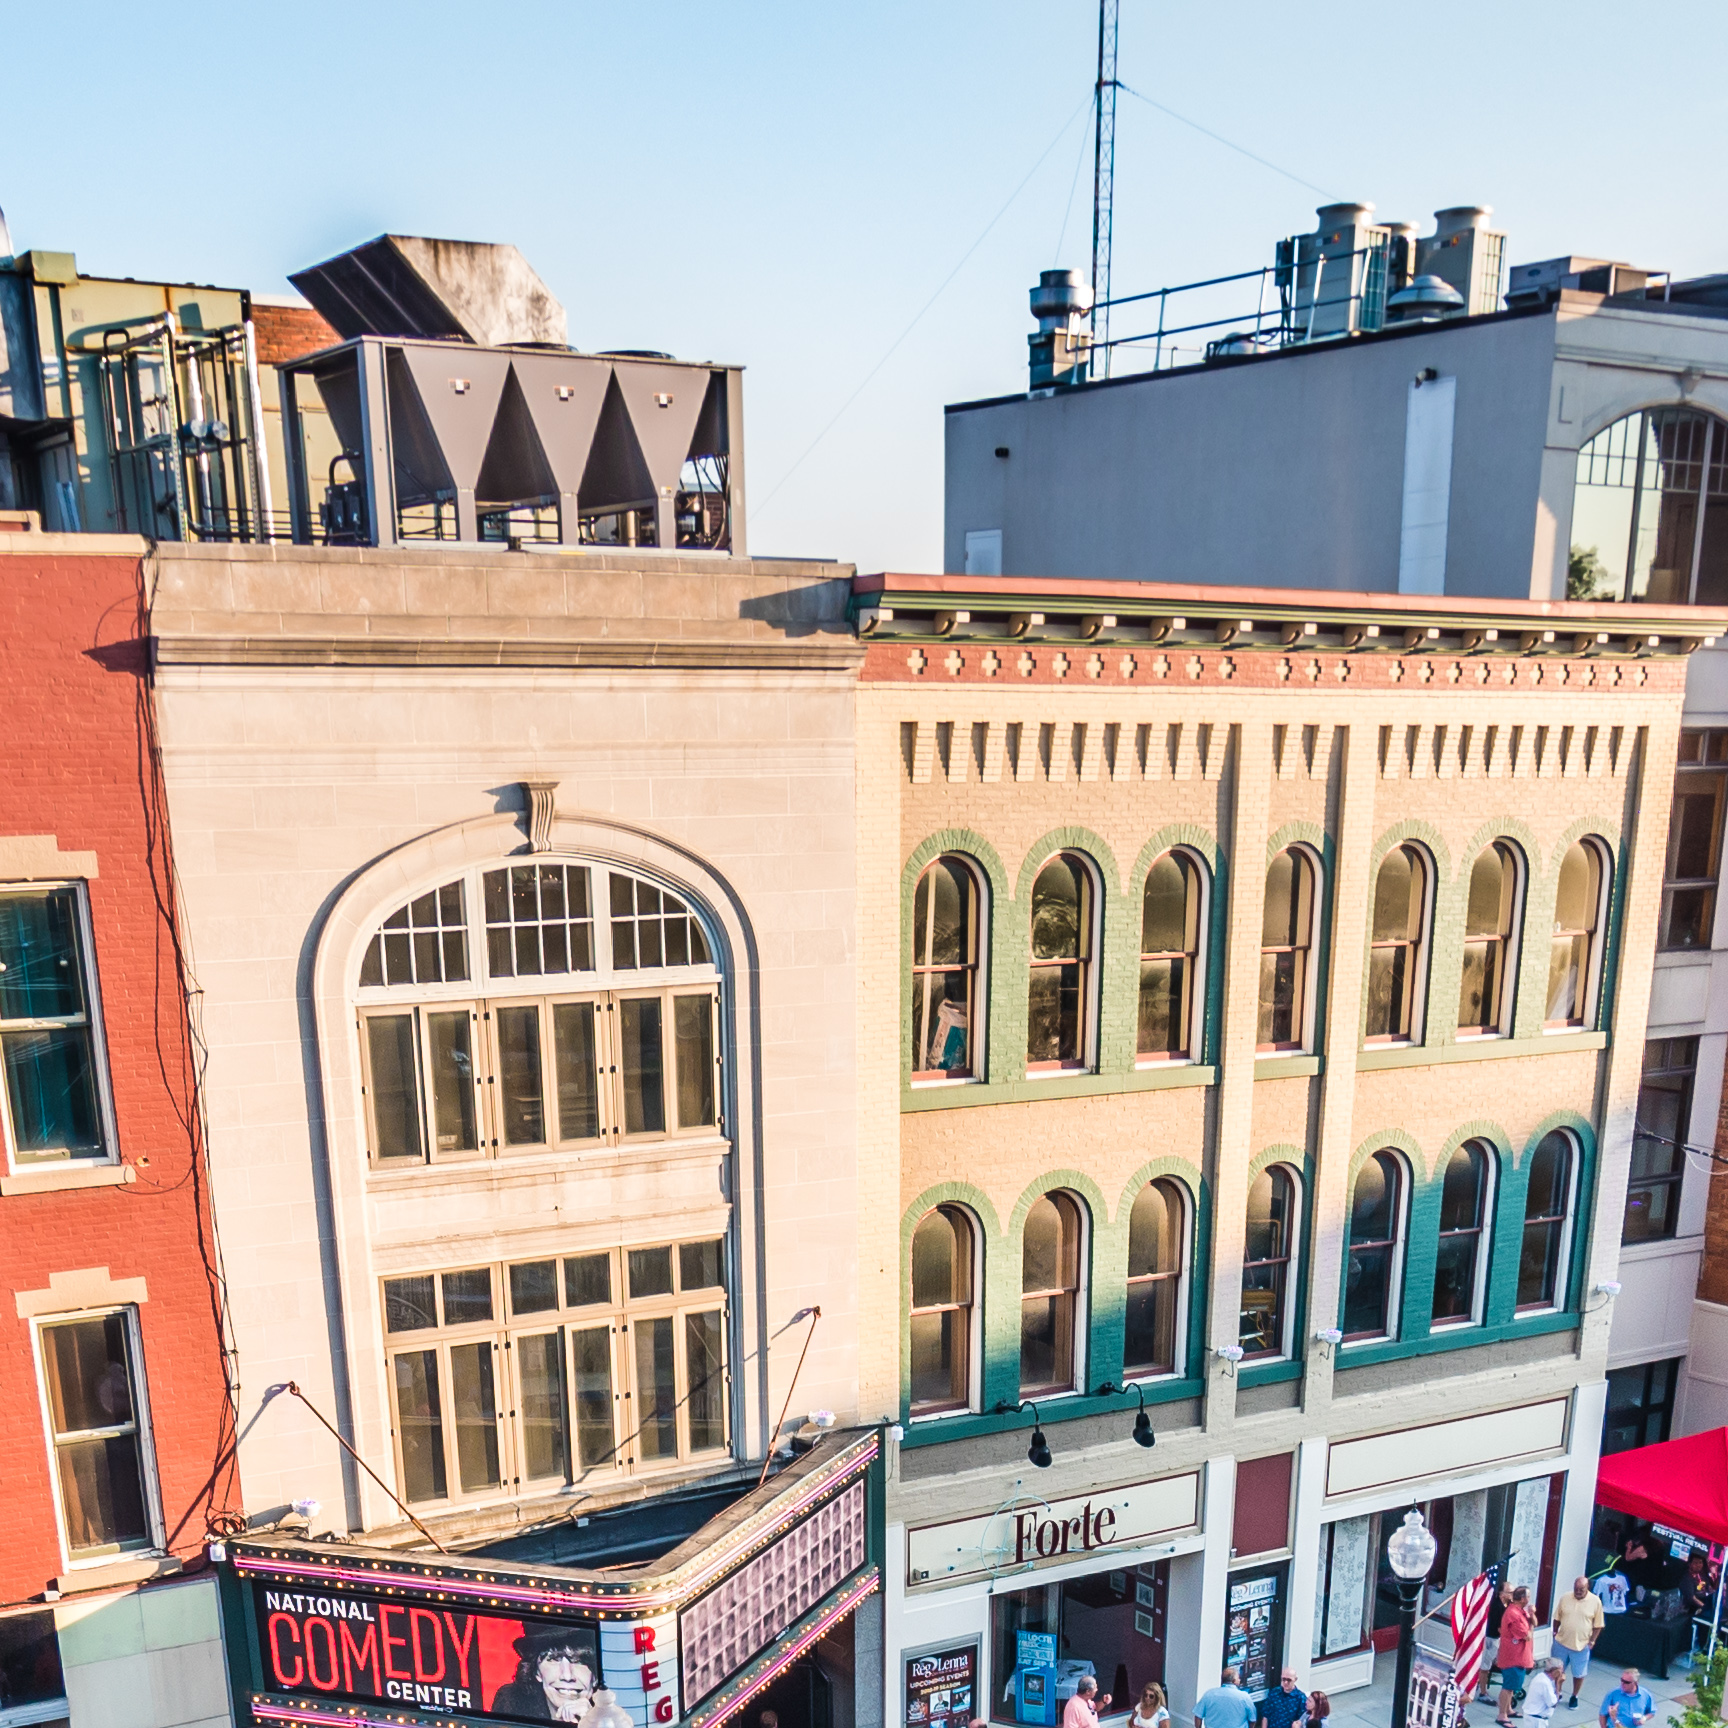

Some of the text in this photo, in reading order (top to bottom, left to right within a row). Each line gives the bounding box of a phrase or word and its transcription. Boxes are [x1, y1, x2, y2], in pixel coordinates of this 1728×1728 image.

[1012, 1500, 1116, 1562] Forte
[1652, 1525, 1684, 1542] FESTIVAL
[265, 1591, 375, 1621] NATIONAL
[268, 1603, 476, 1697] COMEDY
[938, 1655, 968, 1671] Lenna
[909, 1675, 945, 1689] UPCOMING
[946, 1669, 969, 1682] EVENTS
[386, 1680, 472, 1709] CENTER
